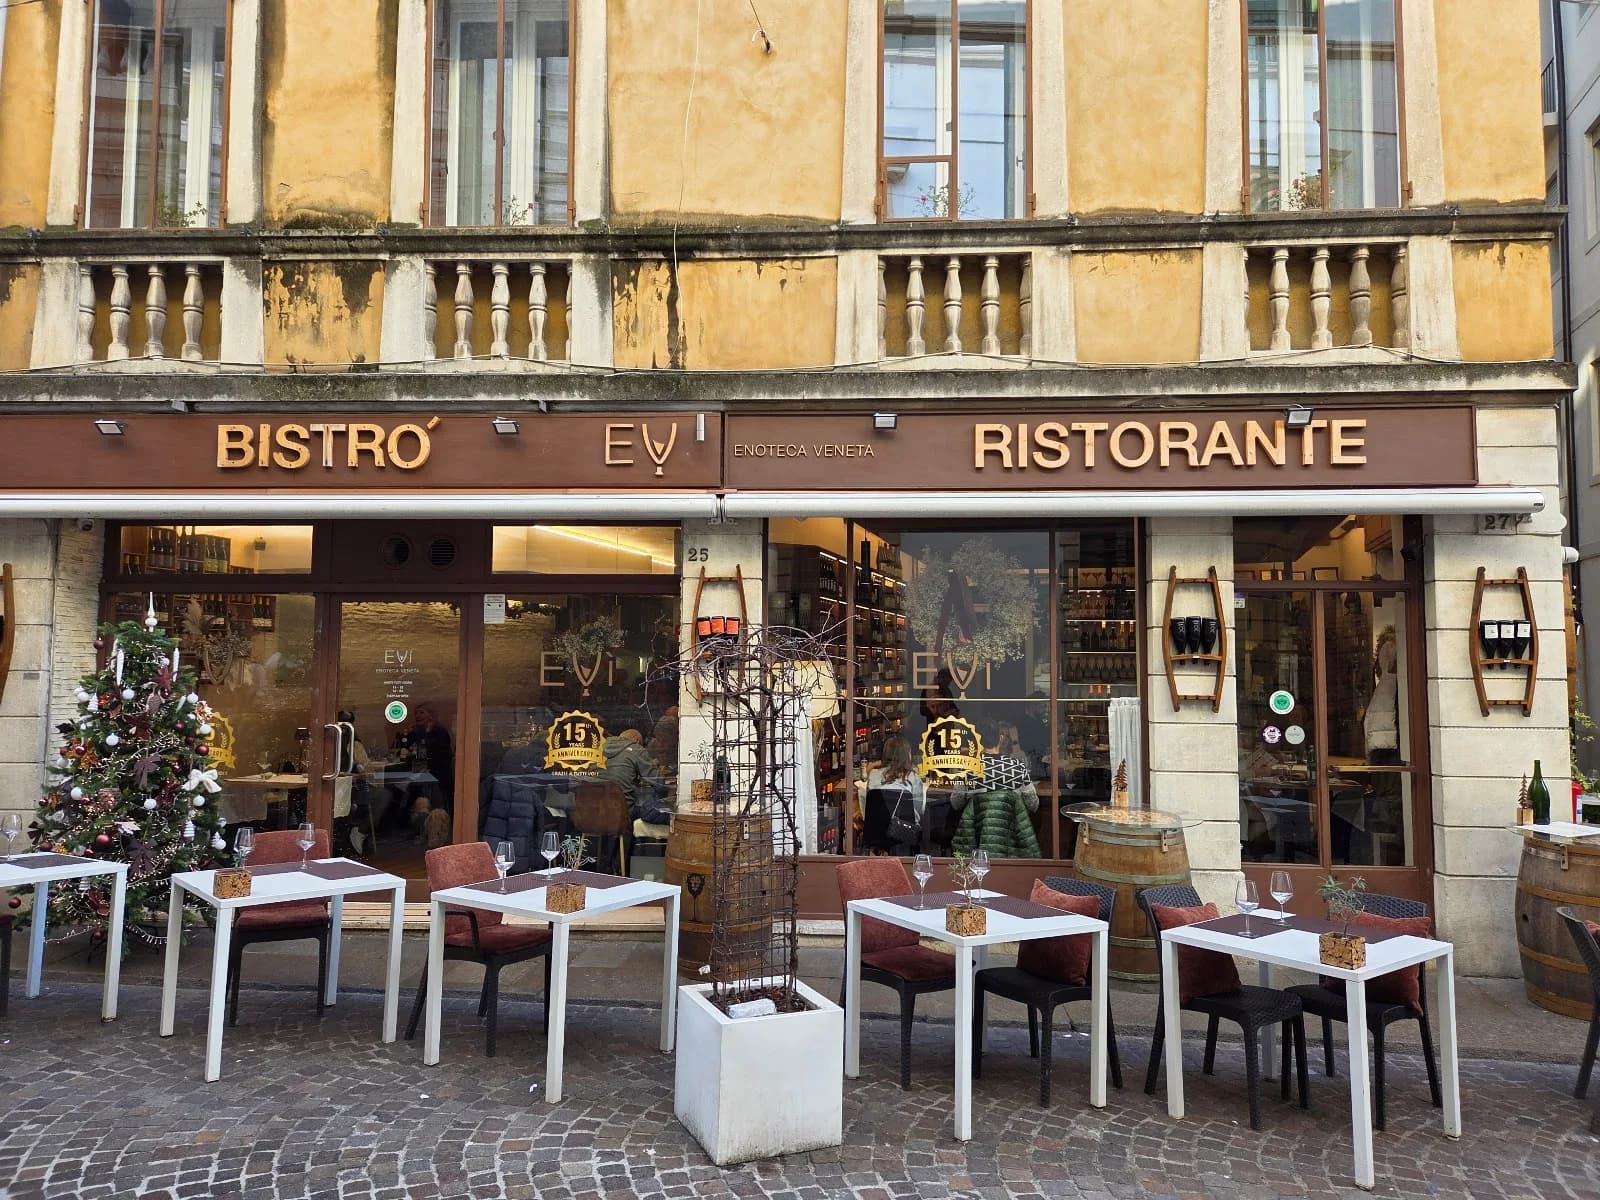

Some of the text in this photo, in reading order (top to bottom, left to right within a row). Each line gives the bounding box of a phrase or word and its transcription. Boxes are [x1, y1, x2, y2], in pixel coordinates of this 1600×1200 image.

[734, 443, 875, 458] ENOTECA VENETA
[974, 418, 1368, 469] RISTORANTE
[687, 547, 709, 562] 25
